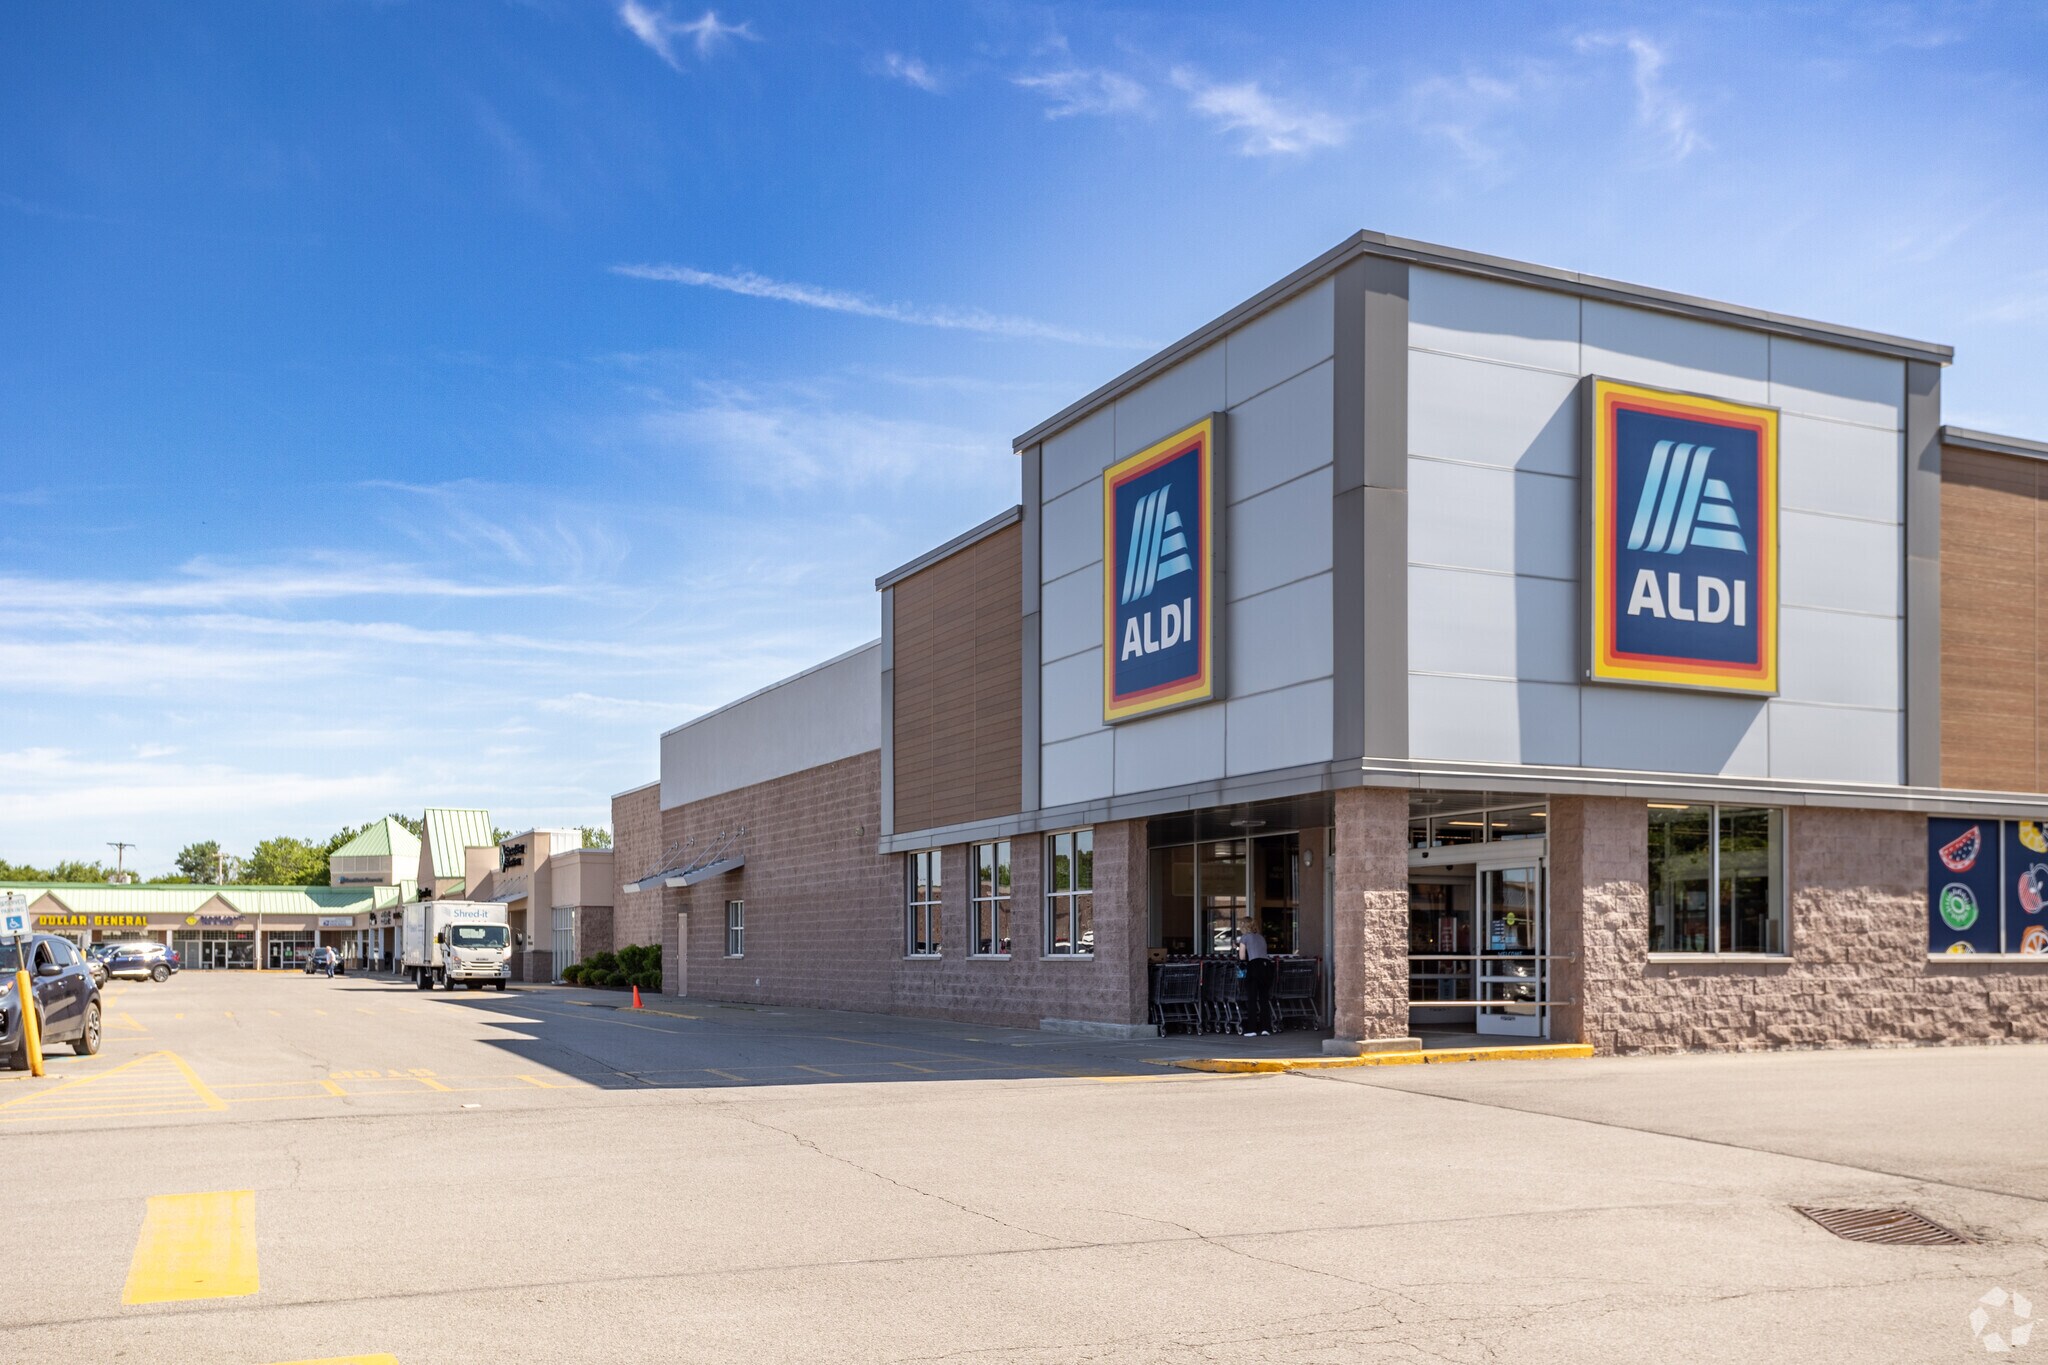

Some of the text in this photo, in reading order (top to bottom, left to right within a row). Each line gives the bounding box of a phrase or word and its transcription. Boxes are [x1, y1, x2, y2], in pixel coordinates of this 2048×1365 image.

[1627, 568, 1746, 627] ALDI
[1121, 597, 1192, 662] ALDI
[39, 915, 148, 926] DOLLAR GENERAL
[454, 909, 489, 918] Shred-it
